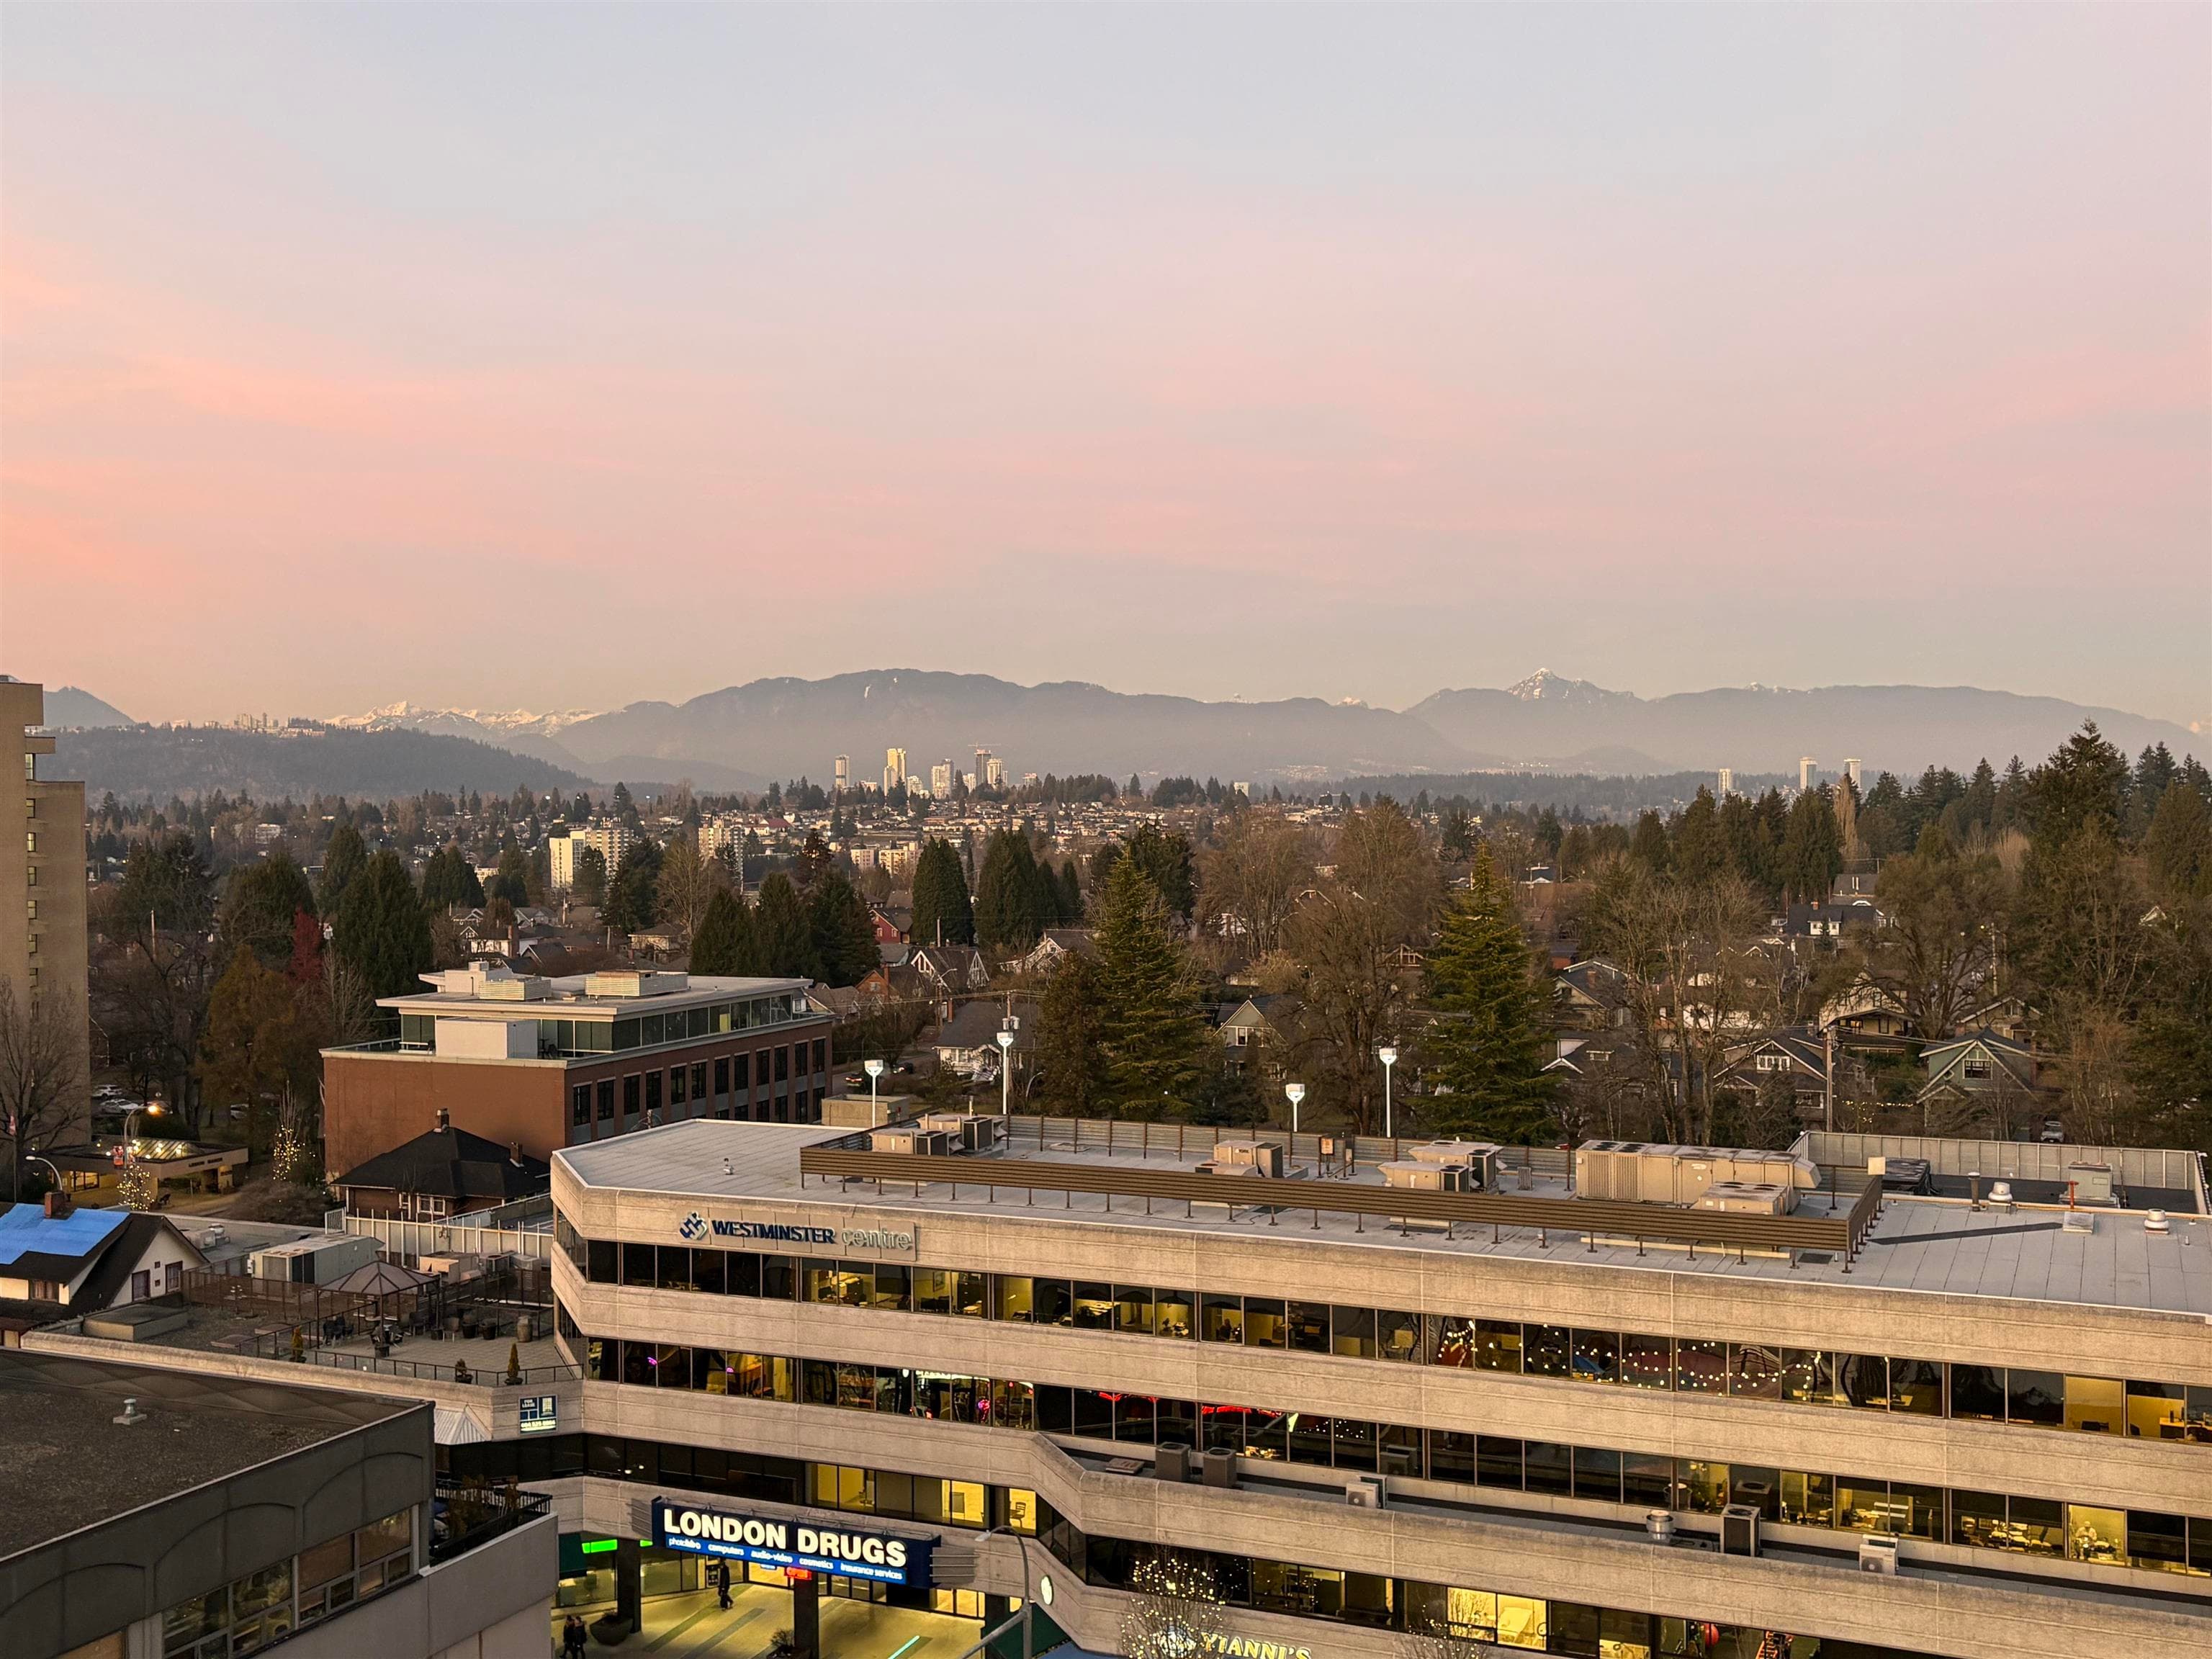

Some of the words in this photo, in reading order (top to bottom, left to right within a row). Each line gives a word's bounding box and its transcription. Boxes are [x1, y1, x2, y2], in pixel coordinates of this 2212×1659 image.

[711, 1220, 836, 1244] WESTMINSTER
[842, 1228, 912, 1251] centre
[664, 1509, 786, 1550] LONDON
[797, 1528, 907, 1568] DRUGS
[799, 1557, 834, 1570] cosmetics
[874, 1568, 903, 1580] services
